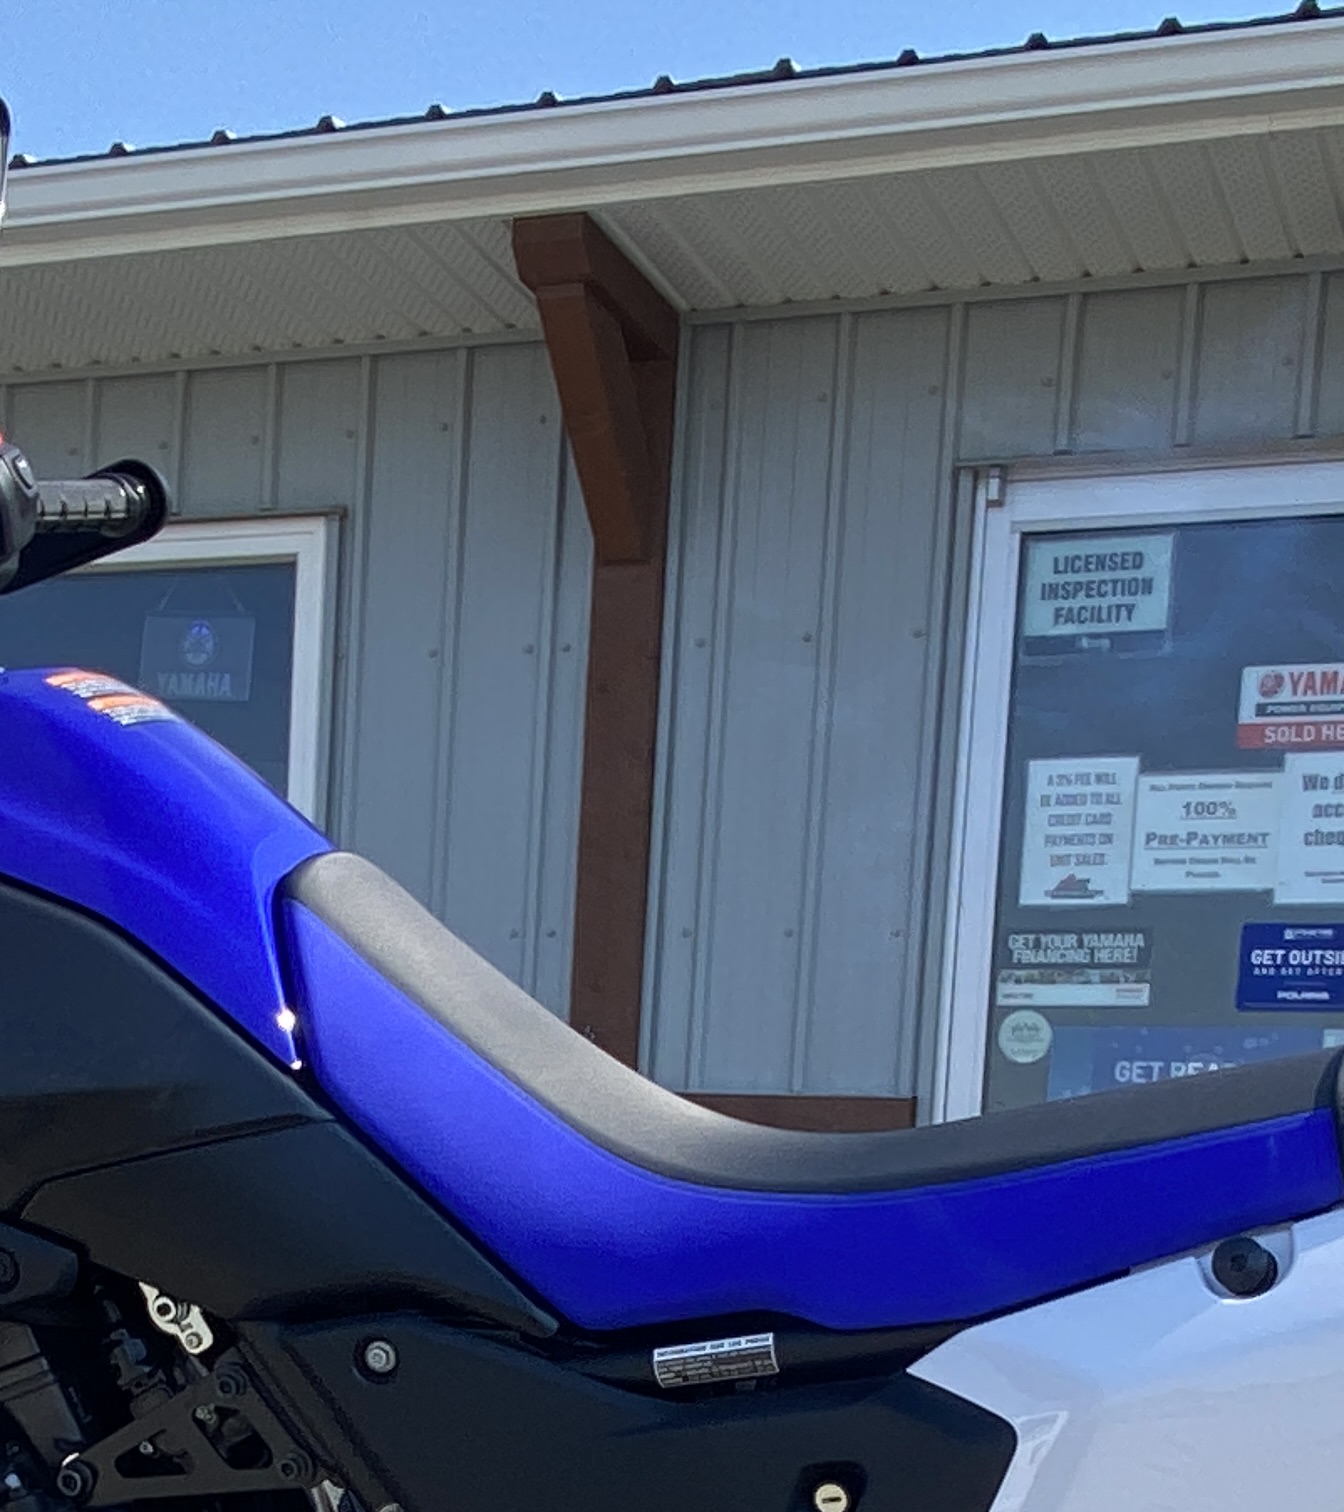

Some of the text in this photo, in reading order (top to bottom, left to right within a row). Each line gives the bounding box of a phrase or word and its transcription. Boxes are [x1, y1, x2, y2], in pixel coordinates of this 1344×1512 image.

[1053, 551, 1145, 575] LICENSED
[1041, 577, 1154, 601] INSPECTION
[1053, 603, 1136, 626] FACILITY
[157, 671, 232, 697] YAMAHA
[1264, 725, 1316, 744] SOLD
[1302, 773, 1330, 792] We
[1182, 800, 1237, 818] 100%
[1008, 934, 1036, 950] GET
[1082, 932, 1146, 949] YAMAHA
[1250, 949, 1286, 966] GET
[1114, 1060, 1165, 1084] GET
